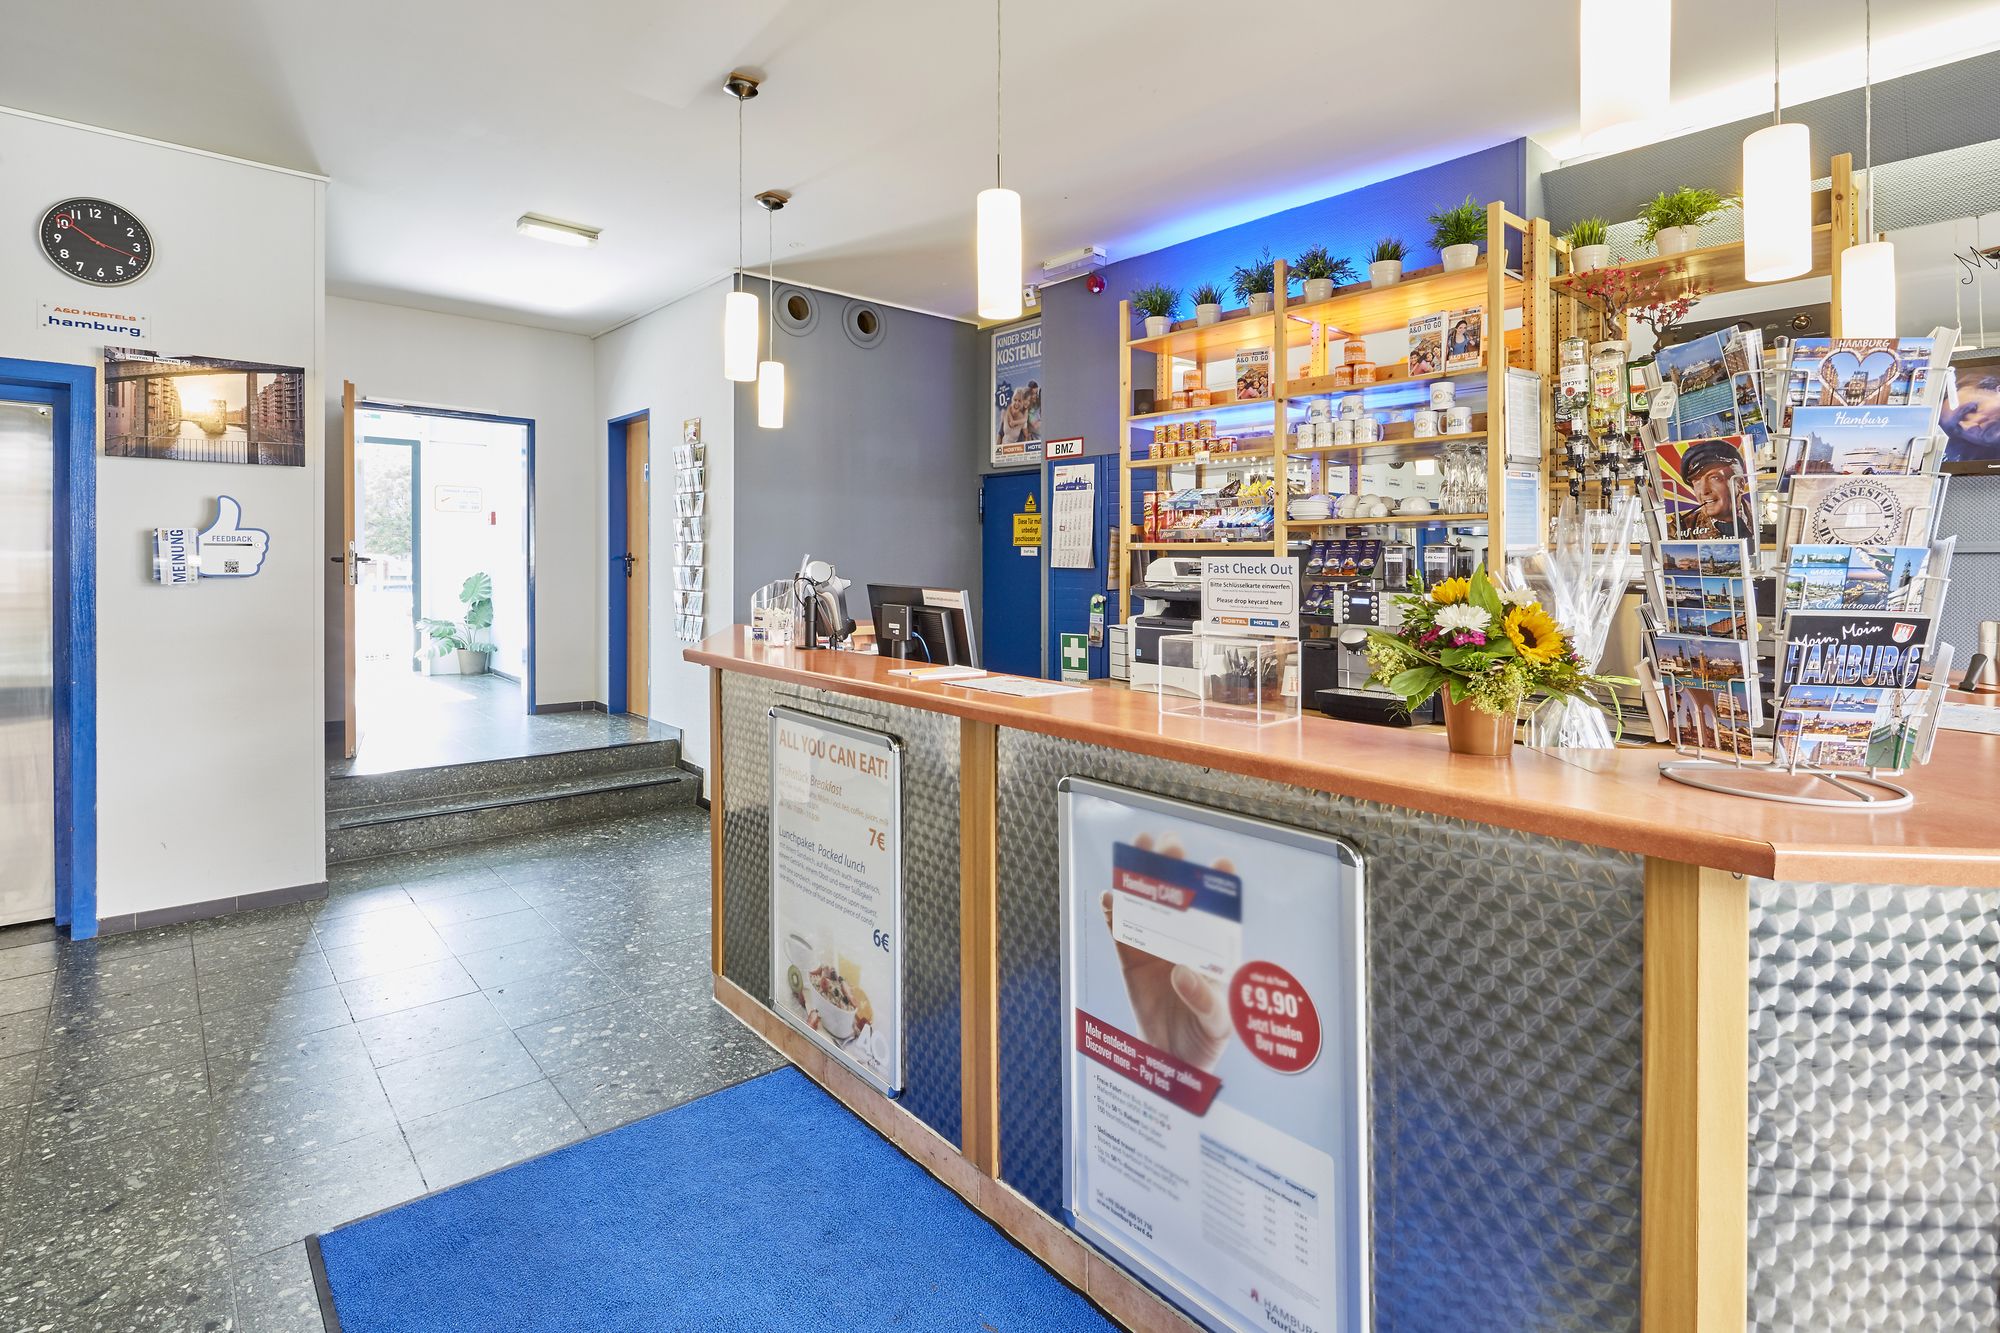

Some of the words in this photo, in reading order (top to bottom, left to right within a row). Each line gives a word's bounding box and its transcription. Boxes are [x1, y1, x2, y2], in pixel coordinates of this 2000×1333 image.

[89, 208, 102, 219] 12
[53, 233, 62, 243] 9
[126, 227, 135, 238] 2
[60, 249, 70, 259] 8
[132, 242, 141, 253] 3
[76, 261, 84, 272] 7
[128, 256, 137, 267] 4
[96, 267, 105, 278] 6
[115, 265, 124, 276] 5
[83, 309, 137, 322] HOSTELS
[48, 315, 141, 338] hamburg
[996, 333, 1019, 349] KINDER
[1838, 339, 1891, 348] HAMBURG
[996, 340, 1041, 366] KOSTENL
[1834, 411, 1890, 428] Hamburg
[1055, 442, 1074, 455] BMZ
[1822, 486, 1894, 519] HANSESTADT
[1692, 527, 1710, 535] der
[211, 535, 253, 543] FEEDBACK
[170, 529, 187, 583] MEINUNG
[1207, 562, 1230, 574] Fast
[1232, 562, 1267, 575] Check
[1270, 563, 1293, 575] Out
[1223, 581, 1261, 589] Schlüsselkarte
[1234, 597, 1248, 606] drop
[1247, 598, 1269, 606] keycard
[1842, 621, 1884, 640] Moin
[1784, 643, 1921, 687] HAMBURG
[778, 728, 800, 751] ALL
[801, 735, 826, 759] YOU
[828, 744, 857, 770] CAN
[859, 753, 888, 781] EAT!
[810, 774, 843, 797] Breakfast
[868, 827, 886, 852] 7€
[778, 825, 815, 853] Lunchpaket
[817, 843, 844, 865] Packed
[843, 853, 866, 875] lunch
[872, 928, 890, 953] 6€
[1241, 983, 1255, 1008] €
[1085, 1020, 1102, 1041] Mehr
[1102, 1032, 1136, 1059] entdecken
[1145, 1055, 1176, 1078] weniger
[1085, 1034, 1112, 1061] Discover
[1113, 1052, 1131, 1071] more
[1139, 1063, 1154, 1086] Pay
[1154, 1072, 1171, 1092] less
[1263, 1297, 1319, 1333] HAMBUR
